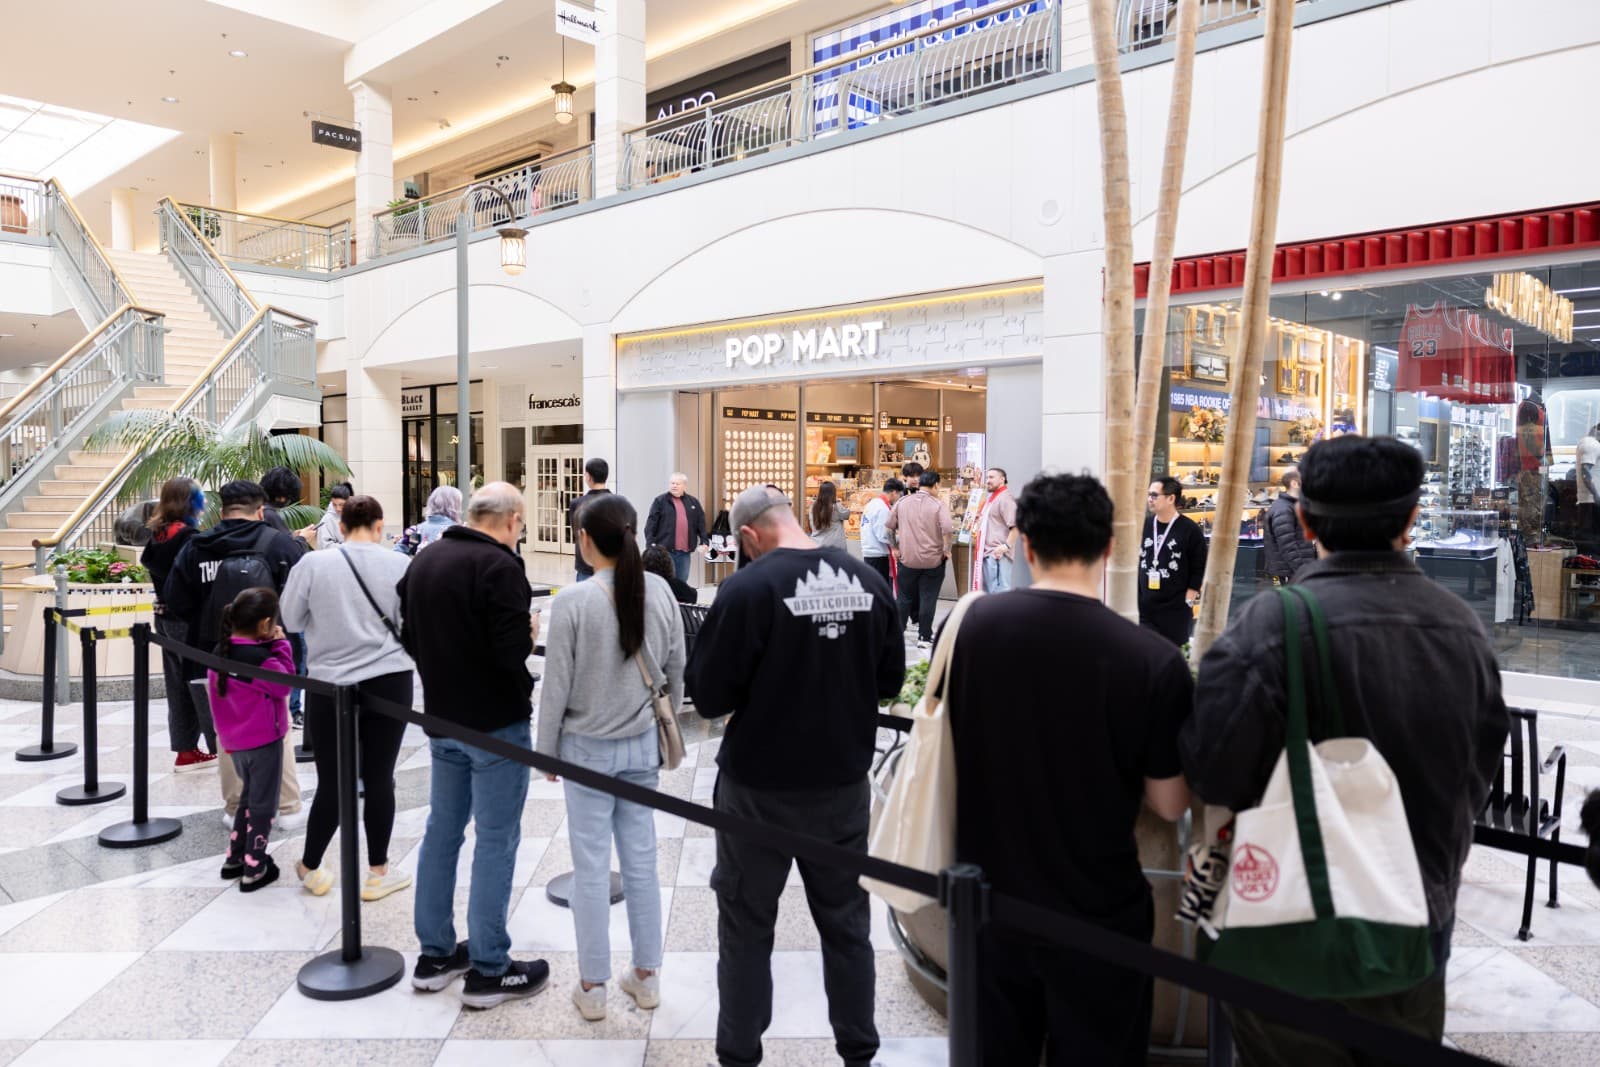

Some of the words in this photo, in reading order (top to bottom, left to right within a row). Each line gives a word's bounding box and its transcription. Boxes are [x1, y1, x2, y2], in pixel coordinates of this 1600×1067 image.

[557, 9, 600, 33] Hallmark
[318, 128, 357, 143] PACSUN
[725, 333, 783, 368] POP
[792, 320, 884, 361] MART
[1412, 340, 1437, 358] 23
[529, 393, 581, 410] francesca's
[812, 611, 854, 623] FITNESS
[500, 974, 529, 987] HOKA
